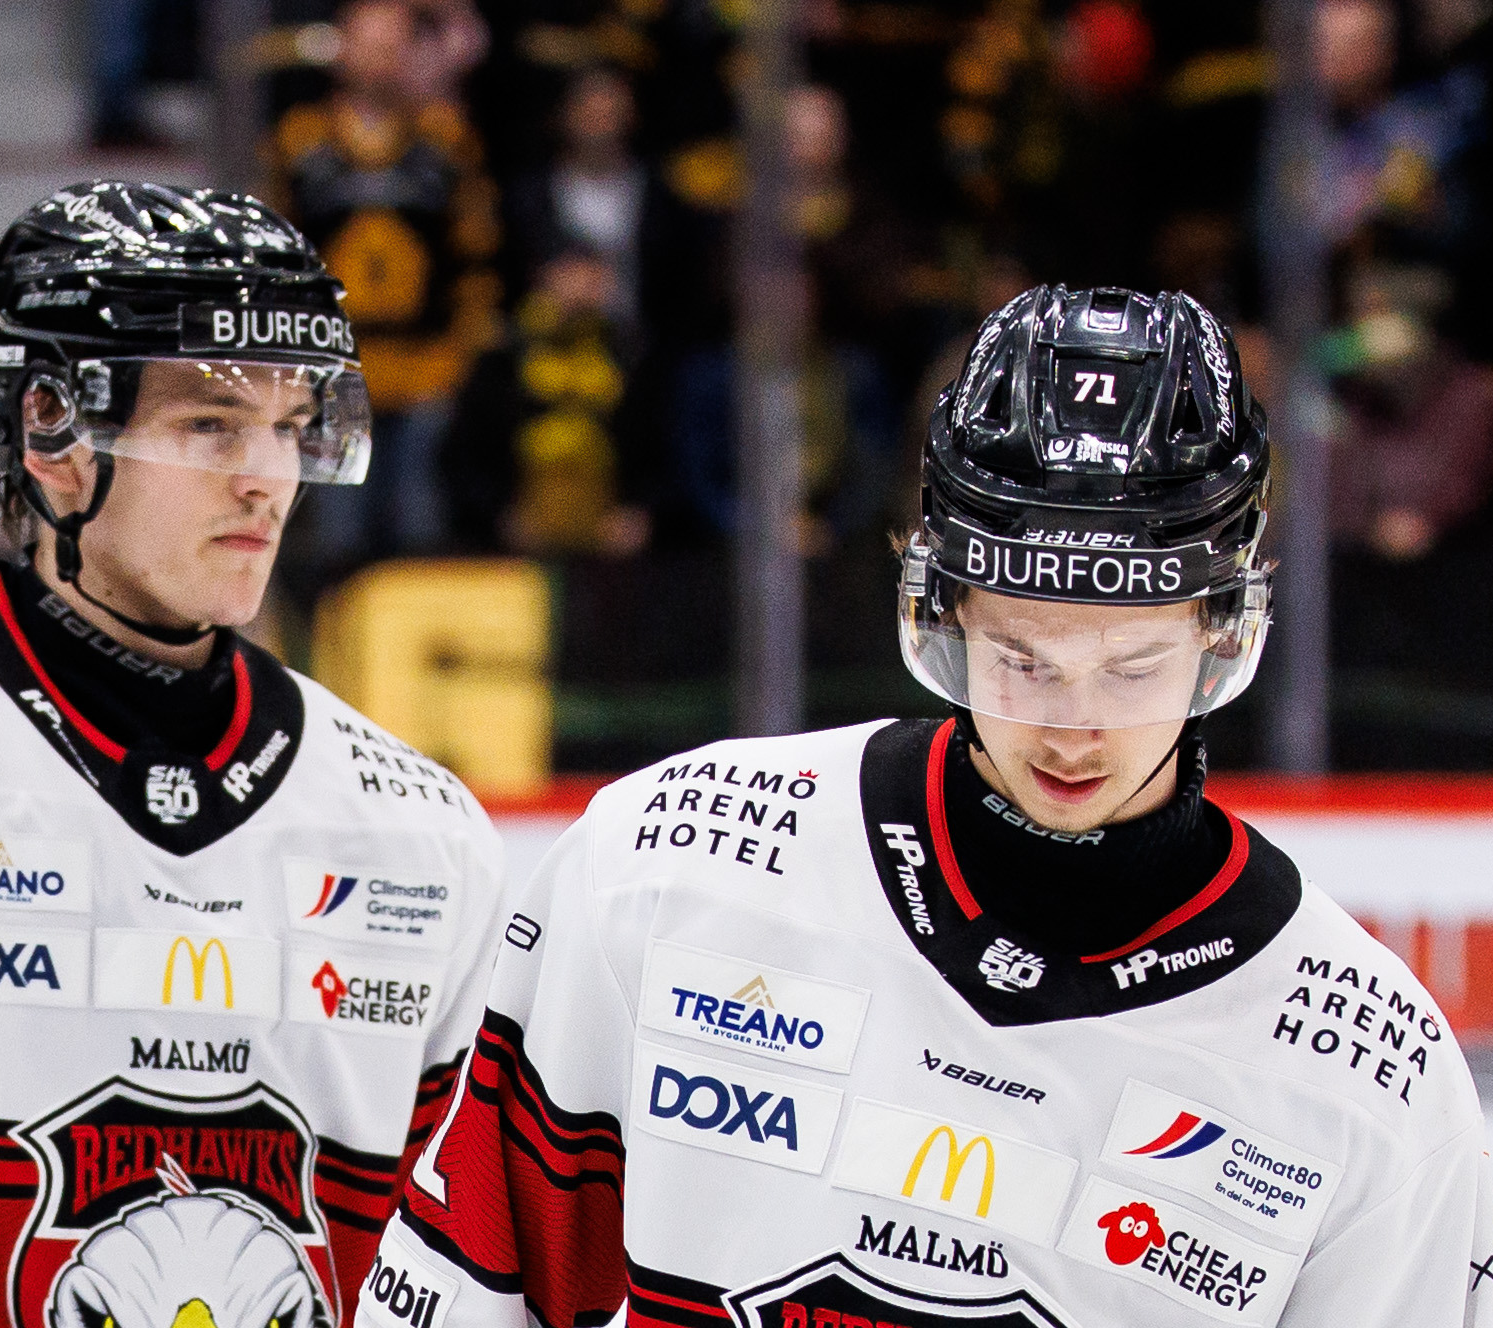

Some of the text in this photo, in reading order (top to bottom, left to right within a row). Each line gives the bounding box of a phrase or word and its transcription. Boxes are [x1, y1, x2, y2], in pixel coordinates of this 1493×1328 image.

[212, 308, 355, 354] BJURFORS
[1073, 371, 1117, 405] 71
[966, 537, 1183, 594] BJURFORS
[657, 761, 820, 800] MALMÖ
[643, 788, 798, 837] ARENA
[634, 823, 785, 876] HOTEL
[367, 900, 443, 921] Gruppen
[368, 878, 449, 901] Climat80
[348, 977, 432, 1005] CHEAP
[977, 947, 1044, 993] 50
[338, 998, 428, 1027] ENERGY
[671, 986, 825, 1051] TREANO
[1295, 954, 1443, 1045] MALMÖ
[128, 1036, 252, 1075] MALMÖ
[699, 1024, 787, 1054] VI BYGGER SKÅNE
[1284, 984, 1429, 1078] ARENA
[941, 1061, 1047, 1107] BAUER
[1272, 1012, 1414, 1107] HOTEL
[649, 1063, 799, 1153] DOXA
[69, 1123, 304, 1220] REDHAWKS
[1221, 1158, 1308, 1211] Gruppen
[1229, 1138, 1324, 1191] Climat80
[855, 1213, 1011, 1281] MALMÖ
[1166, 1230, 1268, 1290] CHEAP
[1140, 1246, 1258, 1313] ENERGY
